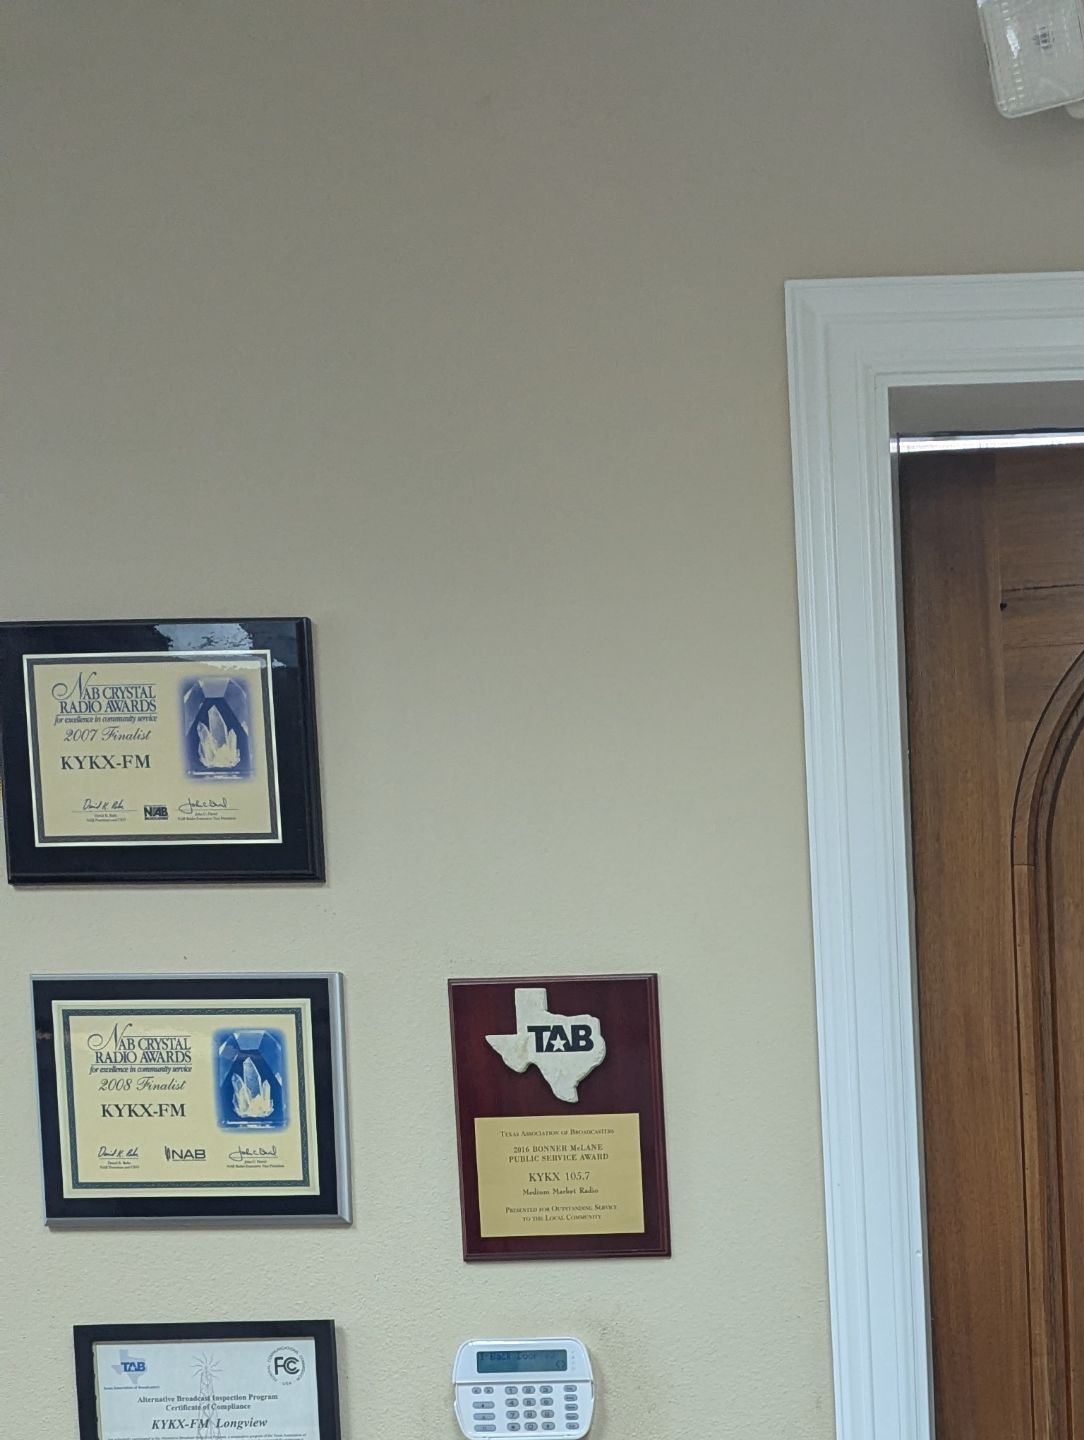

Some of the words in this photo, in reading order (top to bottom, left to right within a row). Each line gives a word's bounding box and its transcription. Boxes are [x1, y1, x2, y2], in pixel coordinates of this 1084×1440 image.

[102, 685, 157, 700] CRYSTAL
[60, 700, 102, 714] RADIO
[104, 700, 157, 713] AWARDS
[63, 728, 99, 742] 2007
[101, 726, 152, 741] Finalist
[60, 754, 151, 770] KYKX-FM
[138, 1037, 192, 1051] CRYSTAL
[526, 1024, 595, 1053] TAB
[95, 1051, 137, 1064] RADIO
[139, 1050, 192, 1063] AWARDS
[89, 1065, 99, 1075] for
[99, 1065, 129, 1073] excellence
[137, 1065, 171, 1075] community
[98, 1078, 133, 1092] 2008
[136, 1076, 187, 1091] Finalist
[101, 1103, 186, 1118] KYKX-FM
[508, 1155, 539, 1163] PUBLIC
[541, 1154, 577, 1162] SERVICE
[580, 1152, 609, 1161] AWARD
[528, 1172, 560, 1182] KYKX
[565, 1171, 590, 1181] 105.7
[522, 1187, 550, 1196] Medium
[552, 1186, 576, 1195] Market
[579, 1186, 599, 1194] Radio
[121, 1361, 146, 1373] TAB
[176, 1395, 211, 1403] Broadcast
[248, 1393, 279, 1402] Program
[211, 1403, 251, 1411] Compliance
[151, 1418, 209, 1430] KYKX-FM
[215, 1417, 268, 1430] Longview
